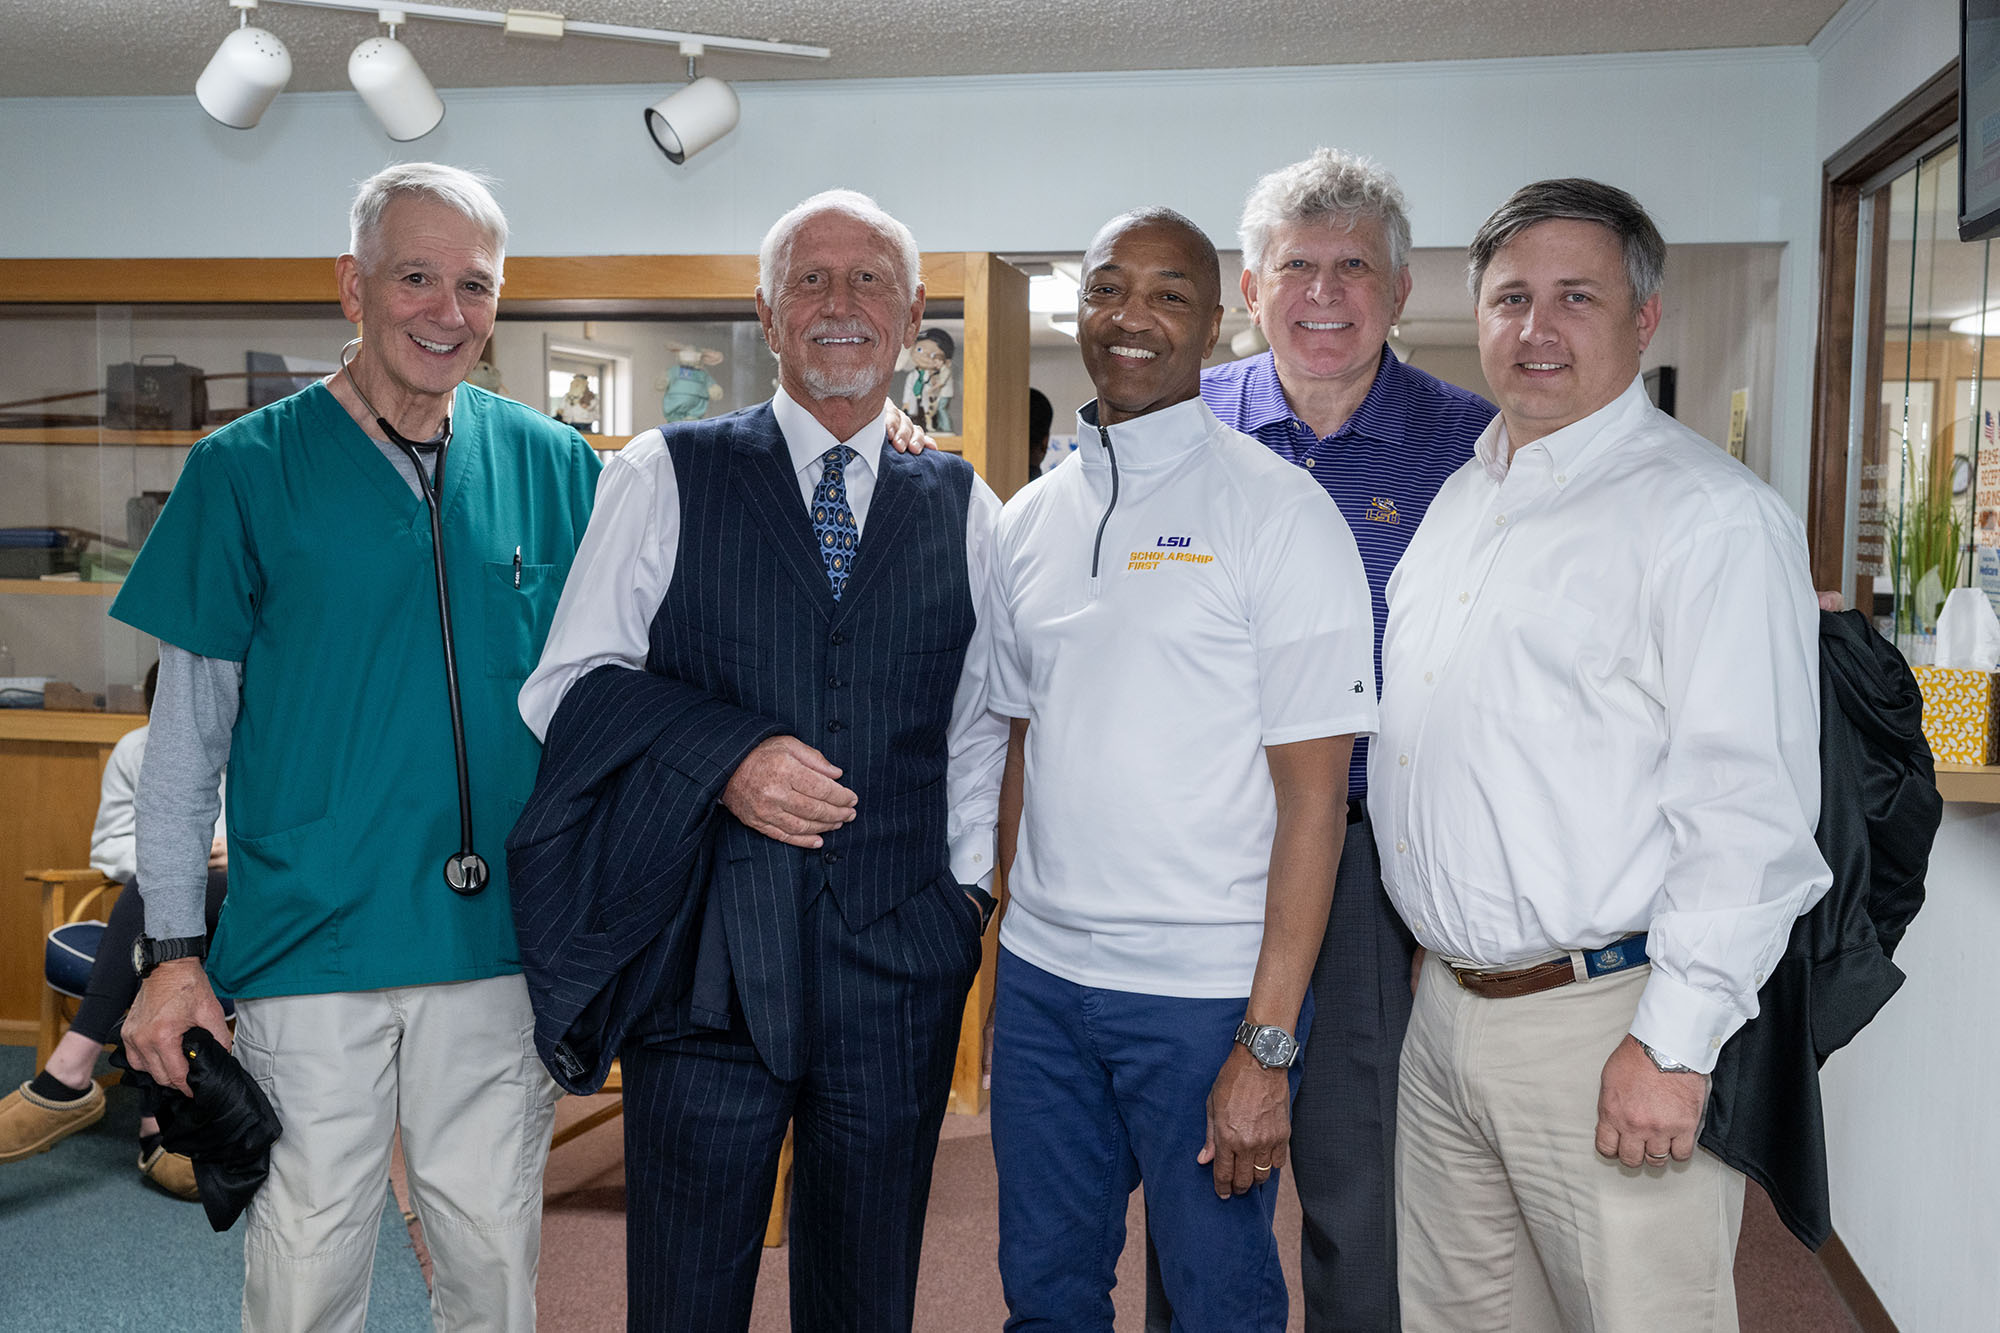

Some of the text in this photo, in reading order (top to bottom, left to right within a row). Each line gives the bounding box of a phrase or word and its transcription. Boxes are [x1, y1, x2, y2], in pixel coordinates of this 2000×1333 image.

[1365, 509, 1401, 525] LSU
[1156, 536, 1192, 548] LSU
[1129, 551, 1214, 564] SCHOLARSHIP
[1127, 561, 1161, 571] FIRST
